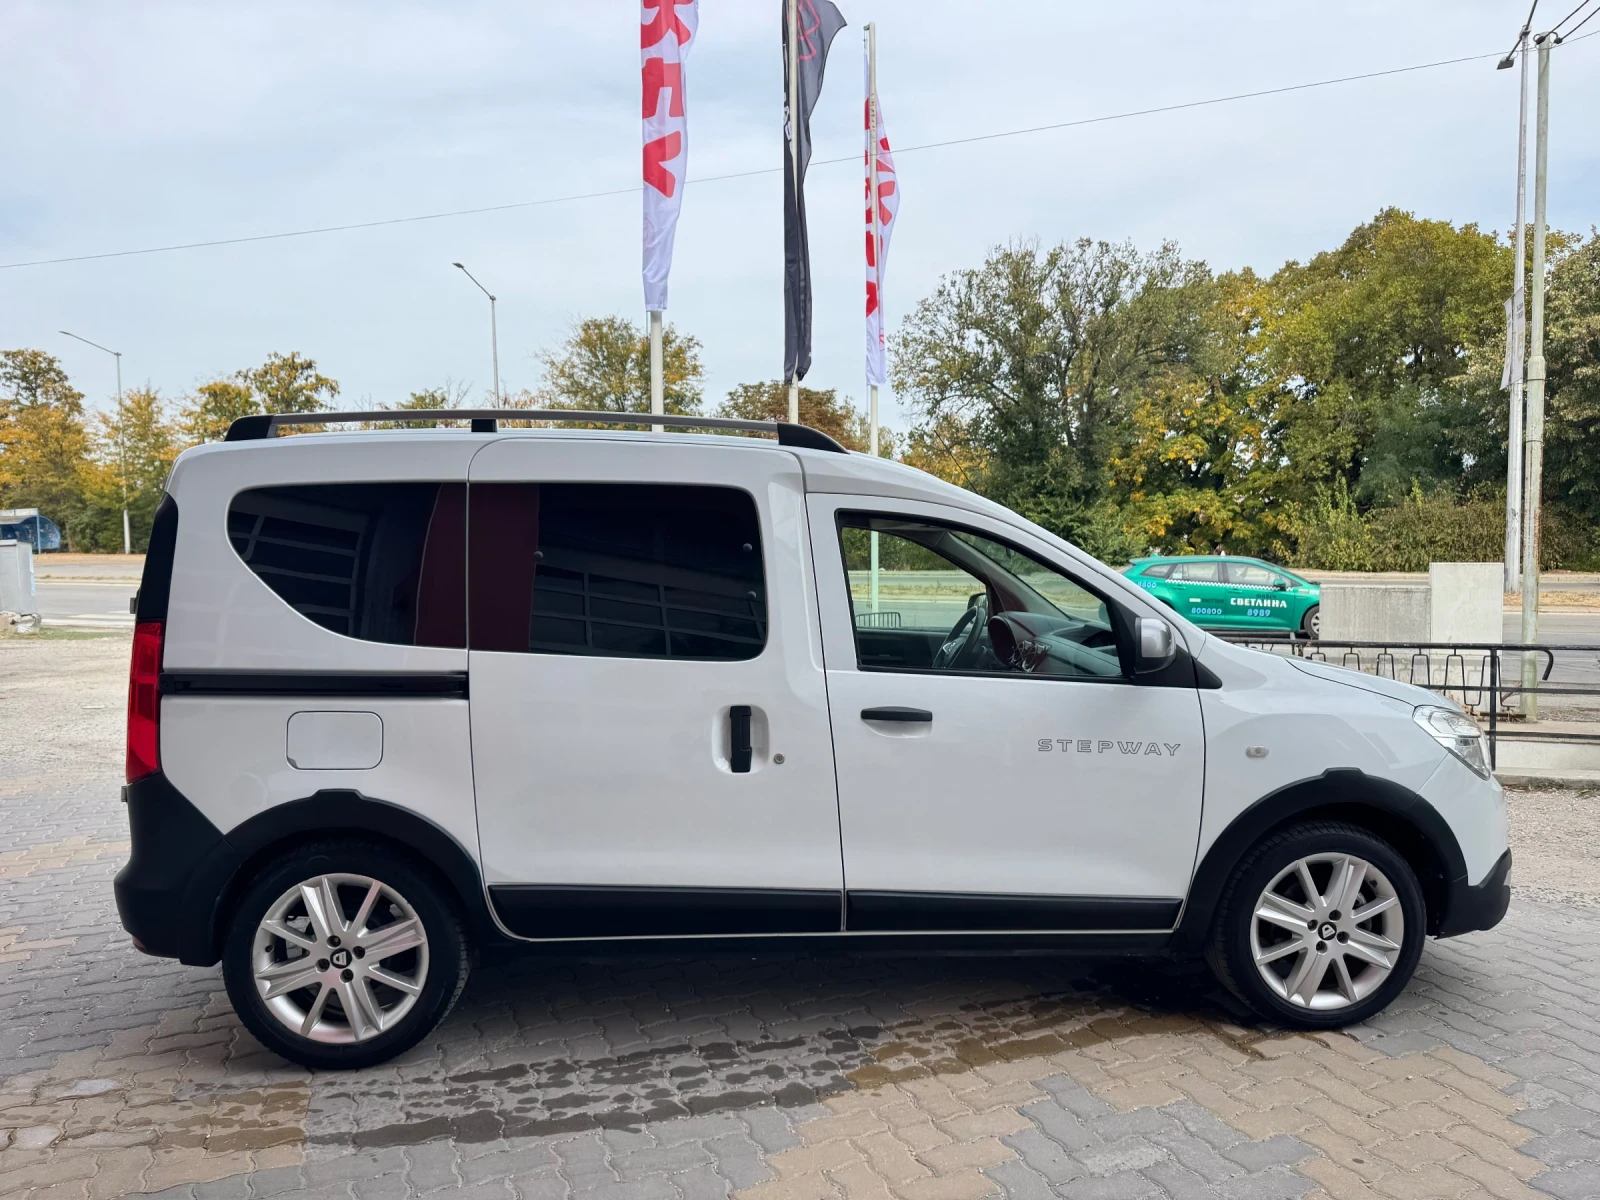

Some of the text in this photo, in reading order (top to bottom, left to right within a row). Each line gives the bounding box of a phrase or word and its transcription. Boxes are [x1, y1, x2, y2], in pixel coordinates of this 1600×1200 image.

[1230, 597, 1287, 608] СВЕТЛИНА
[1191, 607, 1222, 615] 800800
[1247, 608, 1271, 617] 8989
[1037, 738, 1181, 757] STEPWAY
